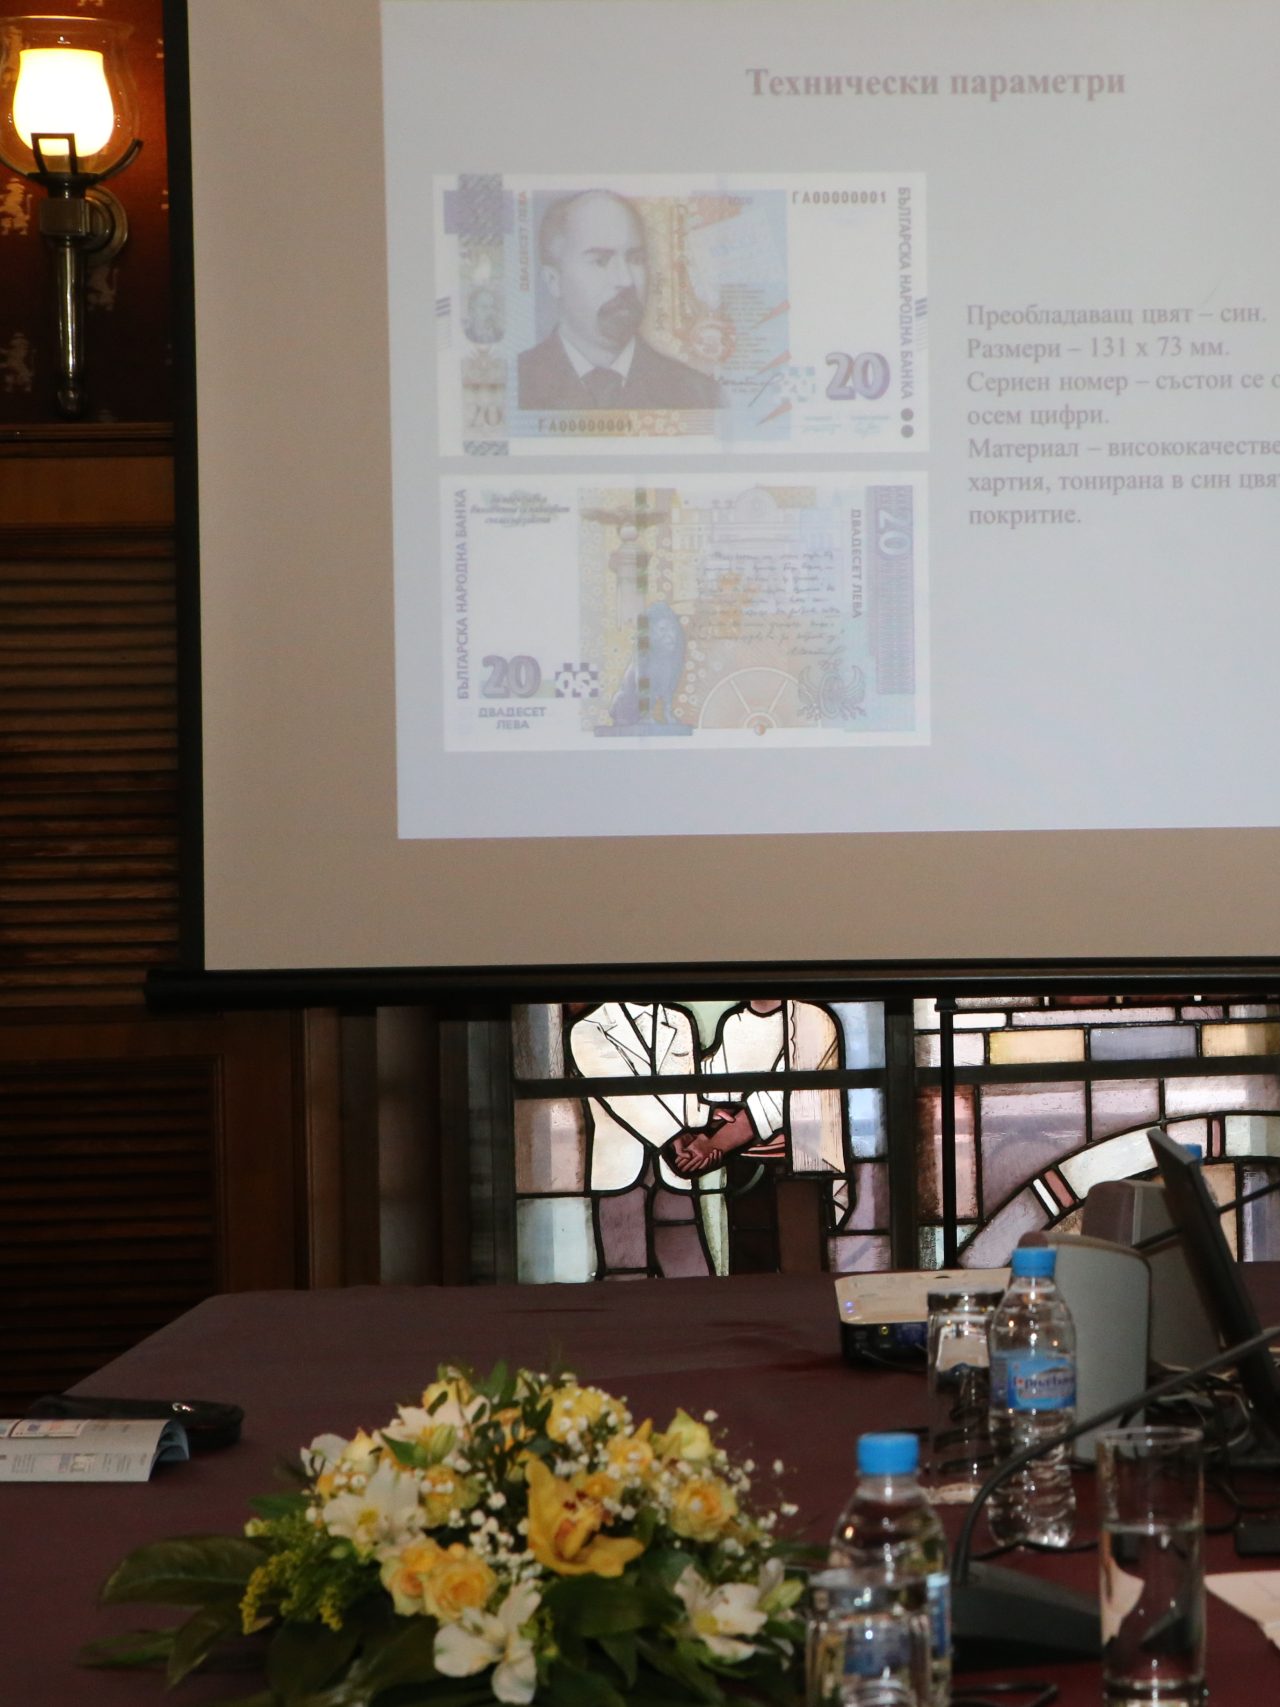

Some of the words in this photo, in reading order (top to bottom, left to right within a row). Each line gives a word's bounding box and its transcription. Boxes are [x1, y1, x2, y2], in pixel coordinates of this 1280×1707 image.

[745, 68, 939, 96] Технически
[950, 73, 1126, 102] параметри
[897, 186, 912, 270] БЪЛГАРСКА
[899, 274, 913, 346] НАРОДНА
[966, 304, 1134, 330] Преобладаващ
[1142, 307, 1193, 325] цвят
[1220, 306, 1267, 323] син.
[966, 338, 1061, 363] Размери
[1091, 336, 1126, 358] 131
[1157, 336, 1183, 357] 73
[1190, 341, 1230, 357] мм.
[825, 351, 891, 401] 20
[900, 351, 914, 400] БАНКА
[966, 371, 1050, 398] Сериен
[1059, 375, 1129, 396] номер
[1155, 373, 1232, 391] състои
[1240, 374, 1265, 389] се
[967, 409, 1022, 425] осем
[1030, 403, 1110, 430] цифри.
[968, 438, 1080, 463] Материал
[968, 474, 1051, 496] хартия,
[1058, 473, 1164, 495] тонирана
[1172, 472, 1184, 488] в
[1190, 471, 1231, 488] син
[454, 489, 467, 538] БАНКА
[969, 508, 1081, 529] покритие.
[850, 508, 863, 581] ДВАДЕСЕТ
[455, 541, 468, 613] НАРОДНА
[851, 583, 864, 619] ЛЕВА
[456, 617, 469, 700] БЪЛГАРСКА
[481, 654, 542, 698] 20
[478, 706, 547, 718] ДВАДЕСЕТ
[496, 720, 530, 730] ЛЕВА
